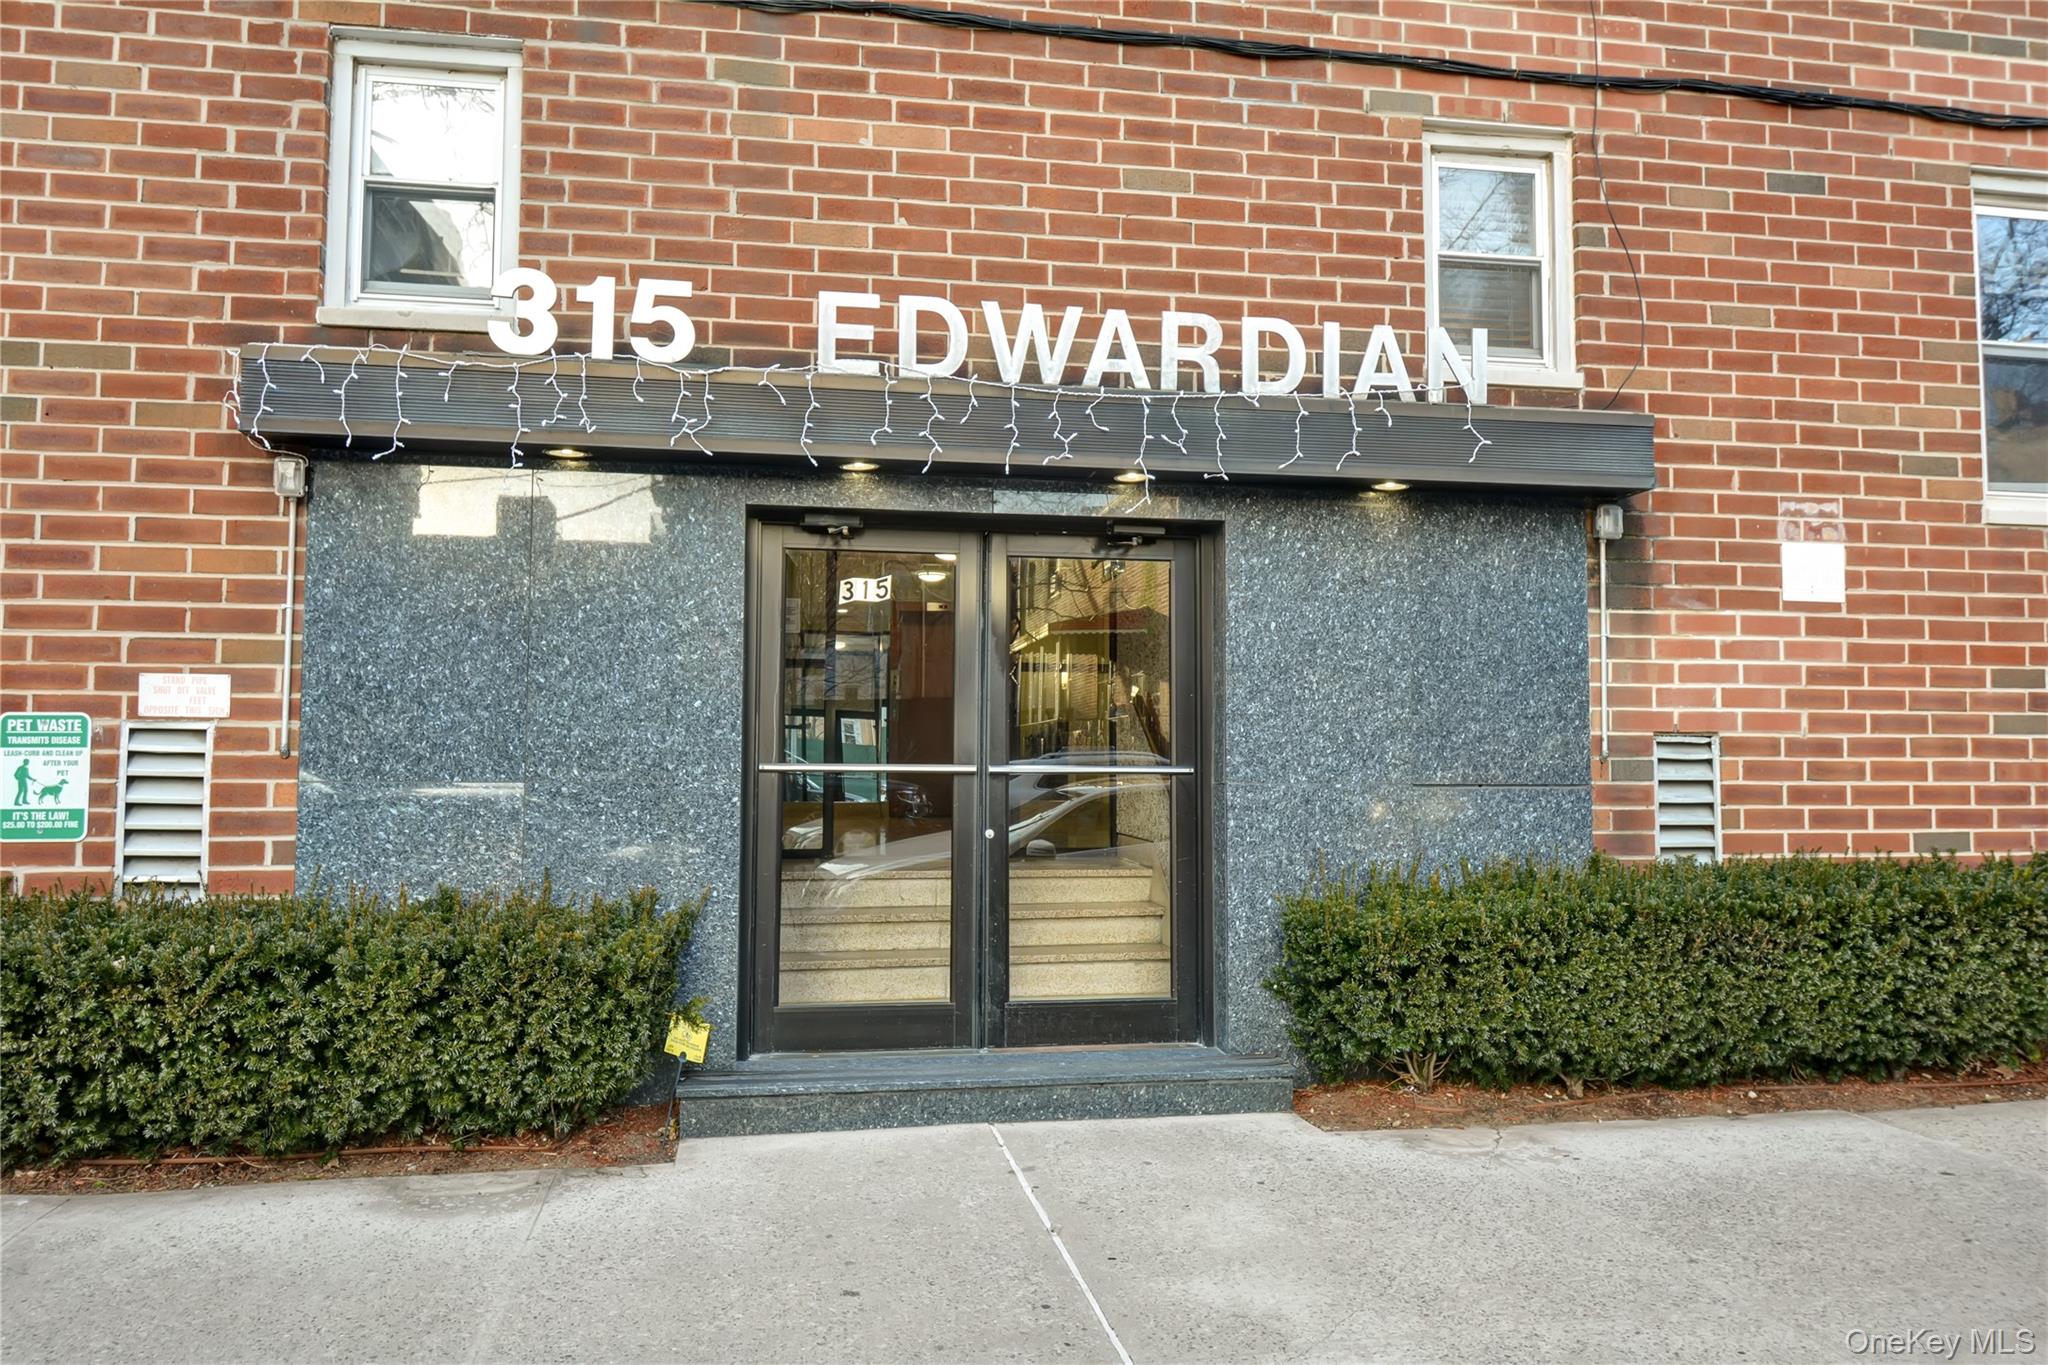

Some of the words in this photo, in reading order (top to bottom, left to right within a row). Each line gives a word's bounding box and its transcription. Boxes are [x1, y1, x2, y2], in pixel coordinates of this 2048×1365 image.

[487, 267, 696, 363] 315
[818, 290, 1488, 405] EDWARDIAN
[842, 578, 888, 600] 315
[7, 719, 32, 732] PET
[37, 719, 82, 732] WASTE
[7, 736, 49, 744] TRANSMITS
[51, 736, 81, 745] DISEASE
[12, 811, 29, 820] IT'S
[31, 811, 46, 821] THE
[48, 811, 69, 821] LAW!
[2, 821, 26, 829] $25.00
[27, 821, 36, 829] TO
[36, 821, 63, 829] $200.00
[64, 821, 79, 829] FINE
